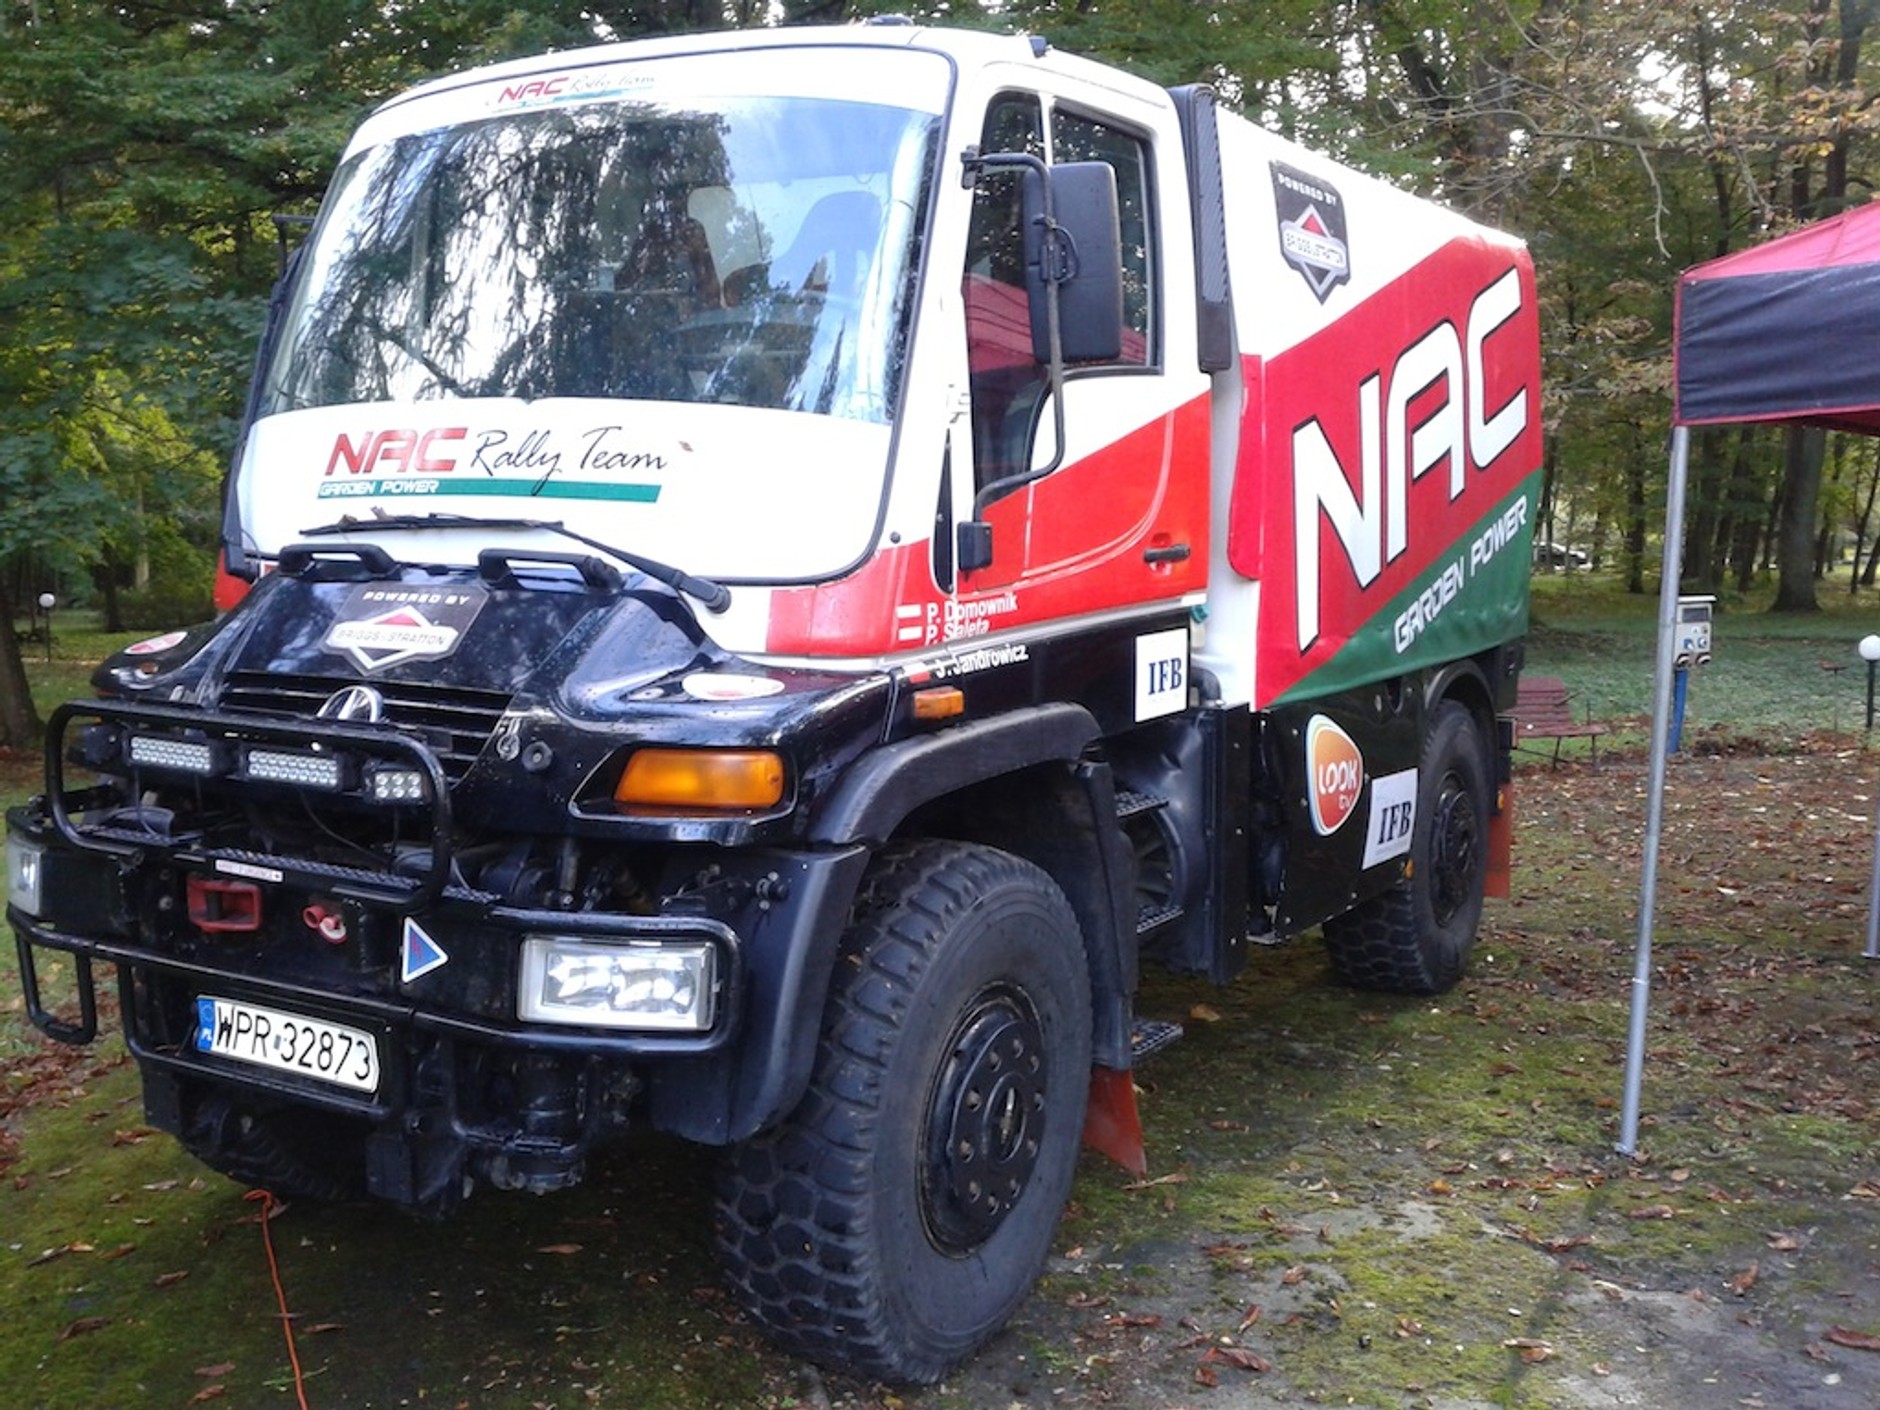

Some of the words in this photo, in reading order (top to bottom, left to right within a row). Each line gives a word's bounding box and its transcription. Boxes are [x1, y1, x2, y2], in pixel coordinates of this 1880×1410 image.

[498, 77, 569, 103] NAC
[325, 427, 468, 476] NAC
[470, 429, 562, 497] Rally
[573, 426, 667, 470] Team
[1292, 265, 1528, 657] NAC
[319, 480, 376, 496] GARDEN
[380, 479, 440, 495] POWER
[1394, 556, 1464, 654] GARDEN
[1470, 495, 1528, 576] POWER
[362, 591, 442, 604] POWERED
[444, 595, 470, 606] BY
[943, 591, 1018, 623] Domownik
[1148, 657, 1182, 696] IFB
[1318, 760, 1358, 795] LOOK
[1377, 800, 1412, 845] IFB
[216, 1005, 272, 1058] WPR
[280, 1021, 371, 1081] 32873
